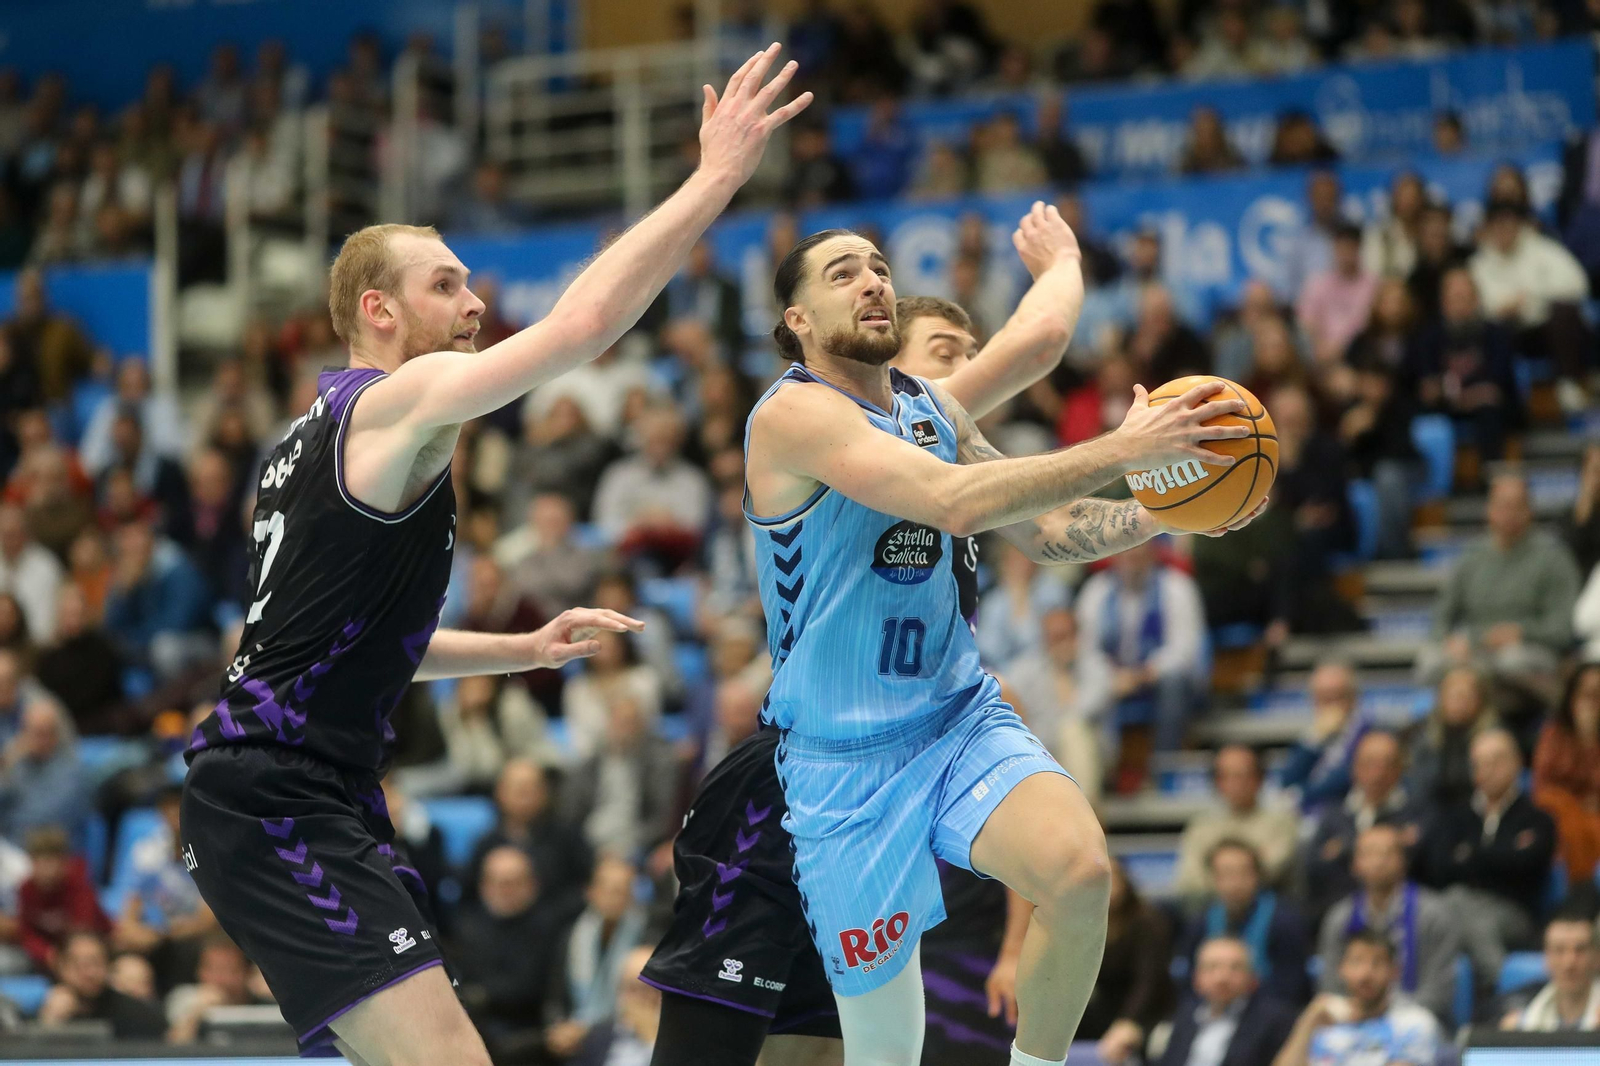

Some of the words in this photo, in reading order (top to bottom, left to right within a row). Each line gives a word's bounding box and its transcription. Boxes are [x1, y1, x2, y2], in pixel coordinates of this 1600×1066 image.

[1125, 459, 1209, 495] Wilson
[882, 545, 928, 565] Galicia
[887, 528, 934, 547] Estrella
[878, 616, 927, 677] 10
[863, 962, 876, 974] DE
[877, 939, 904, 965] GALICIA
